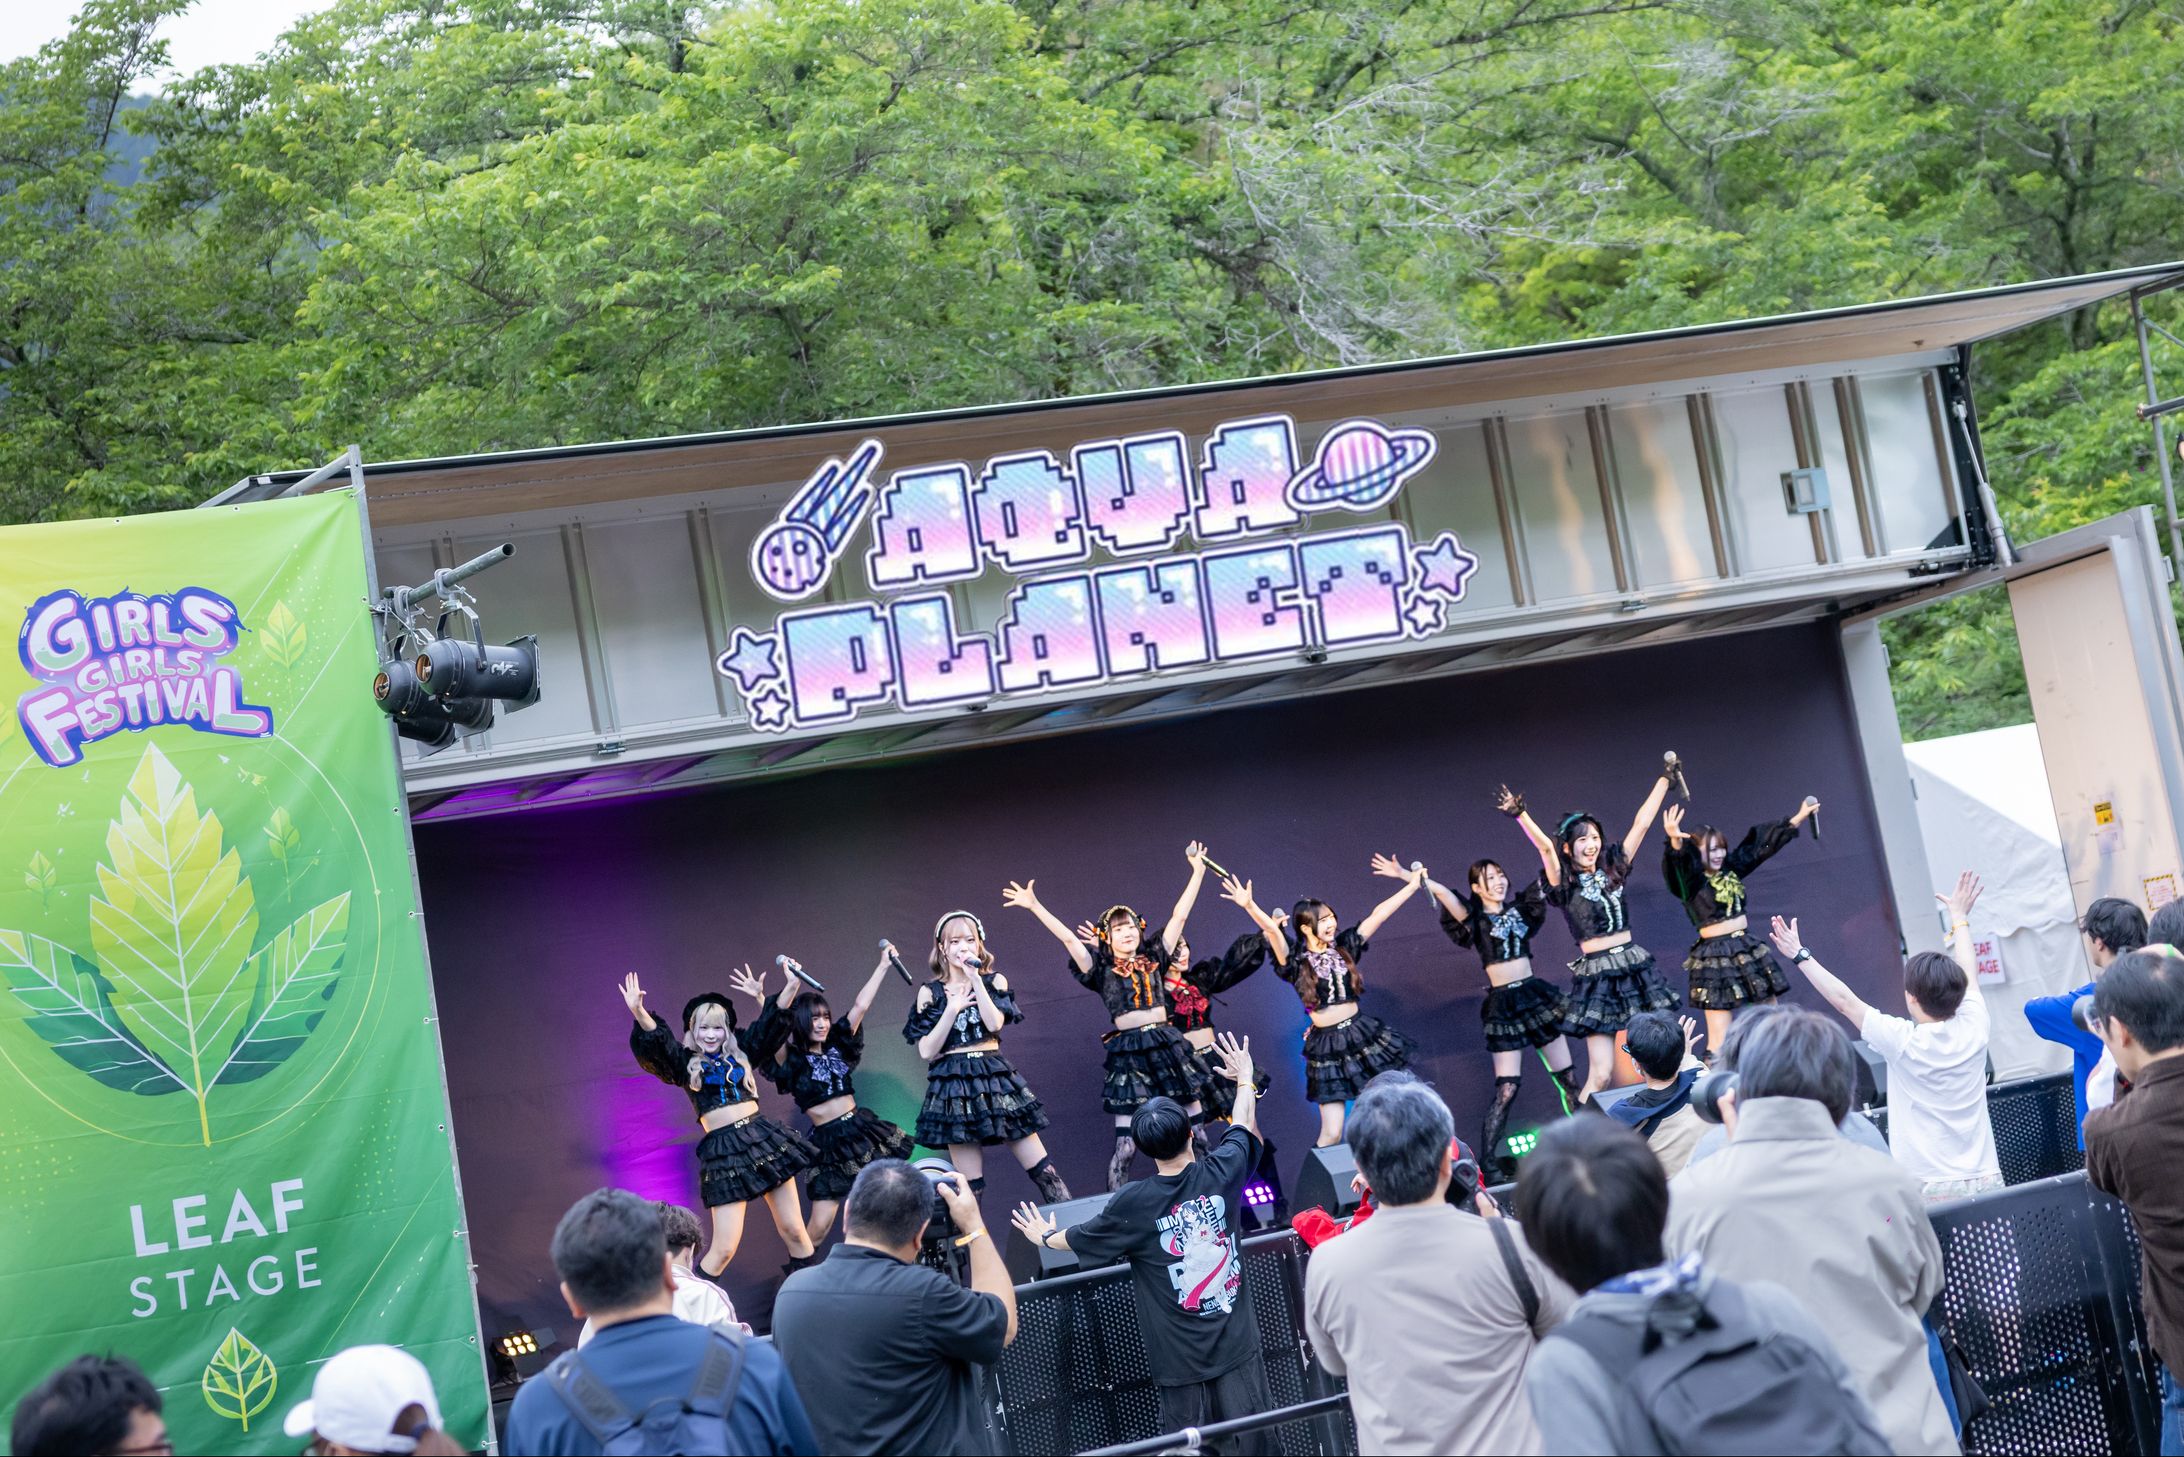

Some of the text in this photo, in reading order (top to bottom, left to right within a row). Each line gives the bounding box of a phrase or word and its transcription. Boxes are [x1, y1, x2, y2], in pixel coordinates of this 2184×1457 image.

[871, 418, 1300, 588] AQUA
[29, 594, 232, 671] GIRLS
[782, 527, 1409, 722] PLANET
[76, 648, 202, 693] GIRLS
[26, 669, 264, 763] FESTIVAL
[1973, 941, 1991, 956] EAF
[1979, 959, 2000, 974] AGE
[130, 1178, 304, 1257] LEAF
[130, 1247, 321, 1318] STAGE
